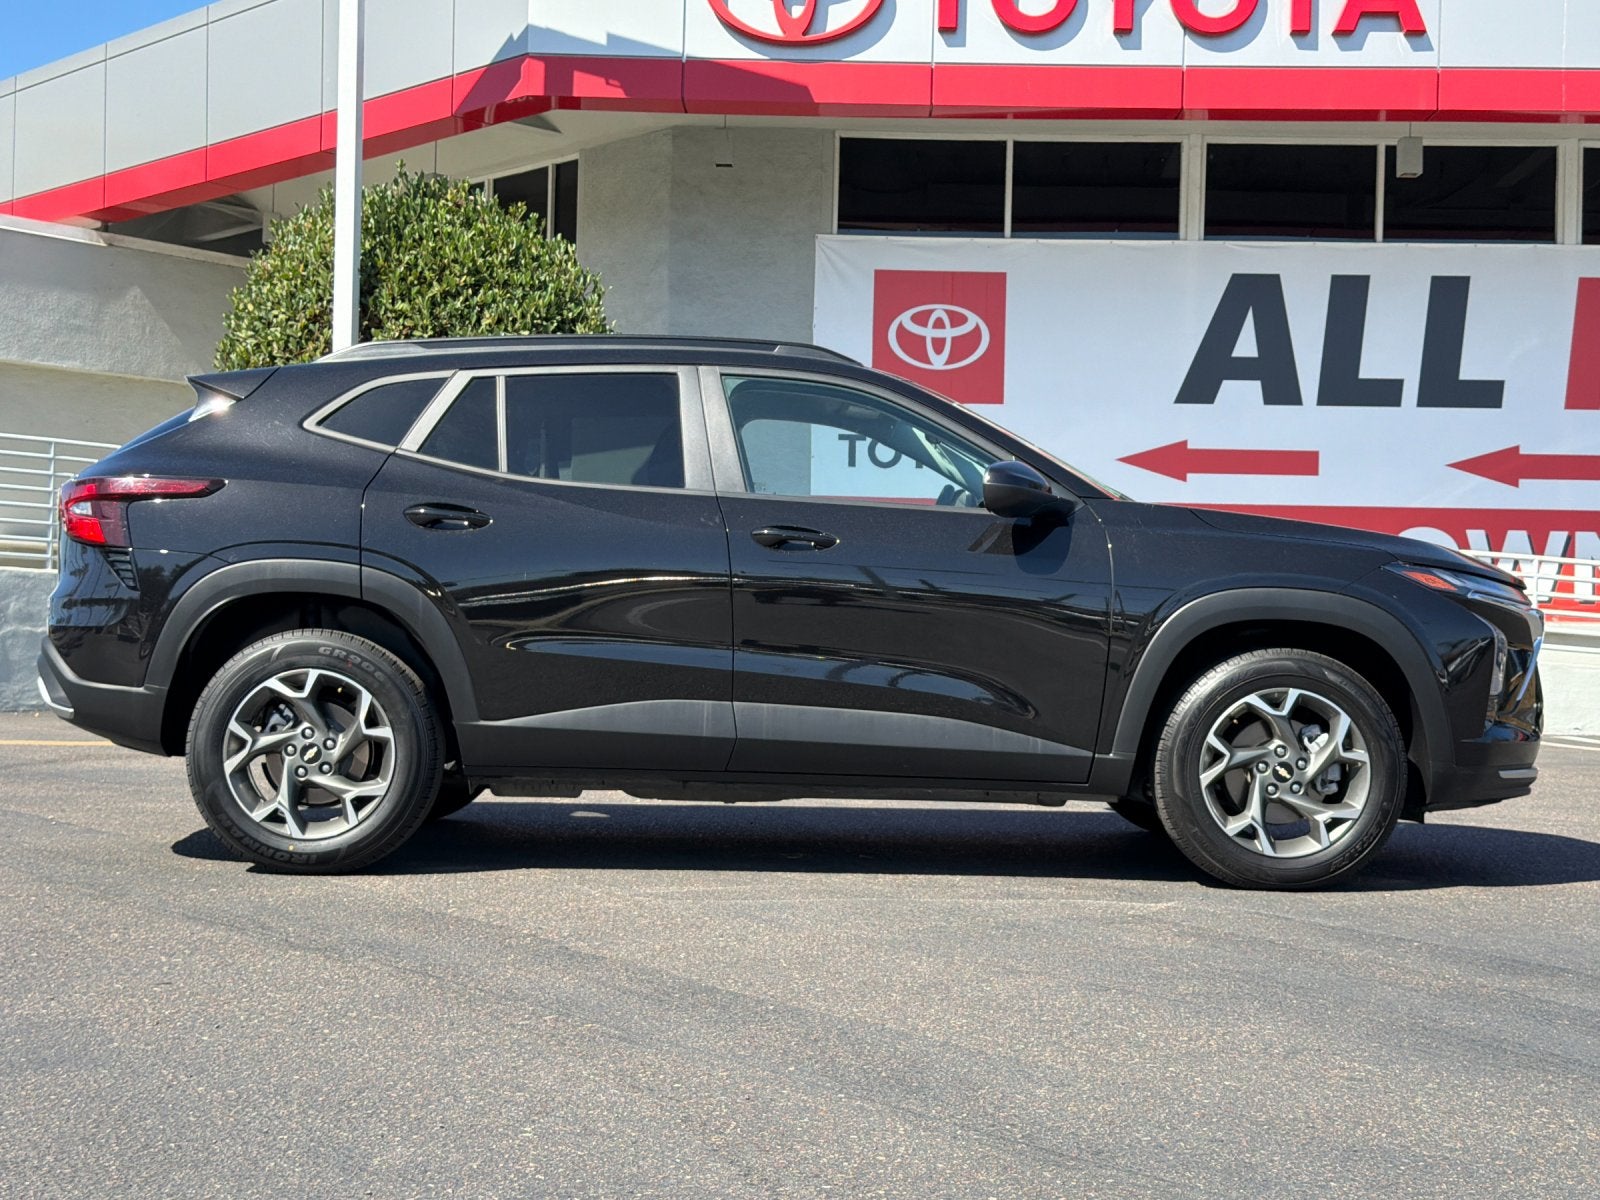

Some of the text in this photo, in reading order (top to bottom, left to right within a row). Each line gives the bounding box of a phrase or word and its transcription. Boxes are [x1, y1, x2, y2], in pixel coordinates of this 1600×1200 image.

[1173, 273, 1505, 408] ALL
[838, 433, 924, 469] TO
[318, 646, 385, 682] GR906
